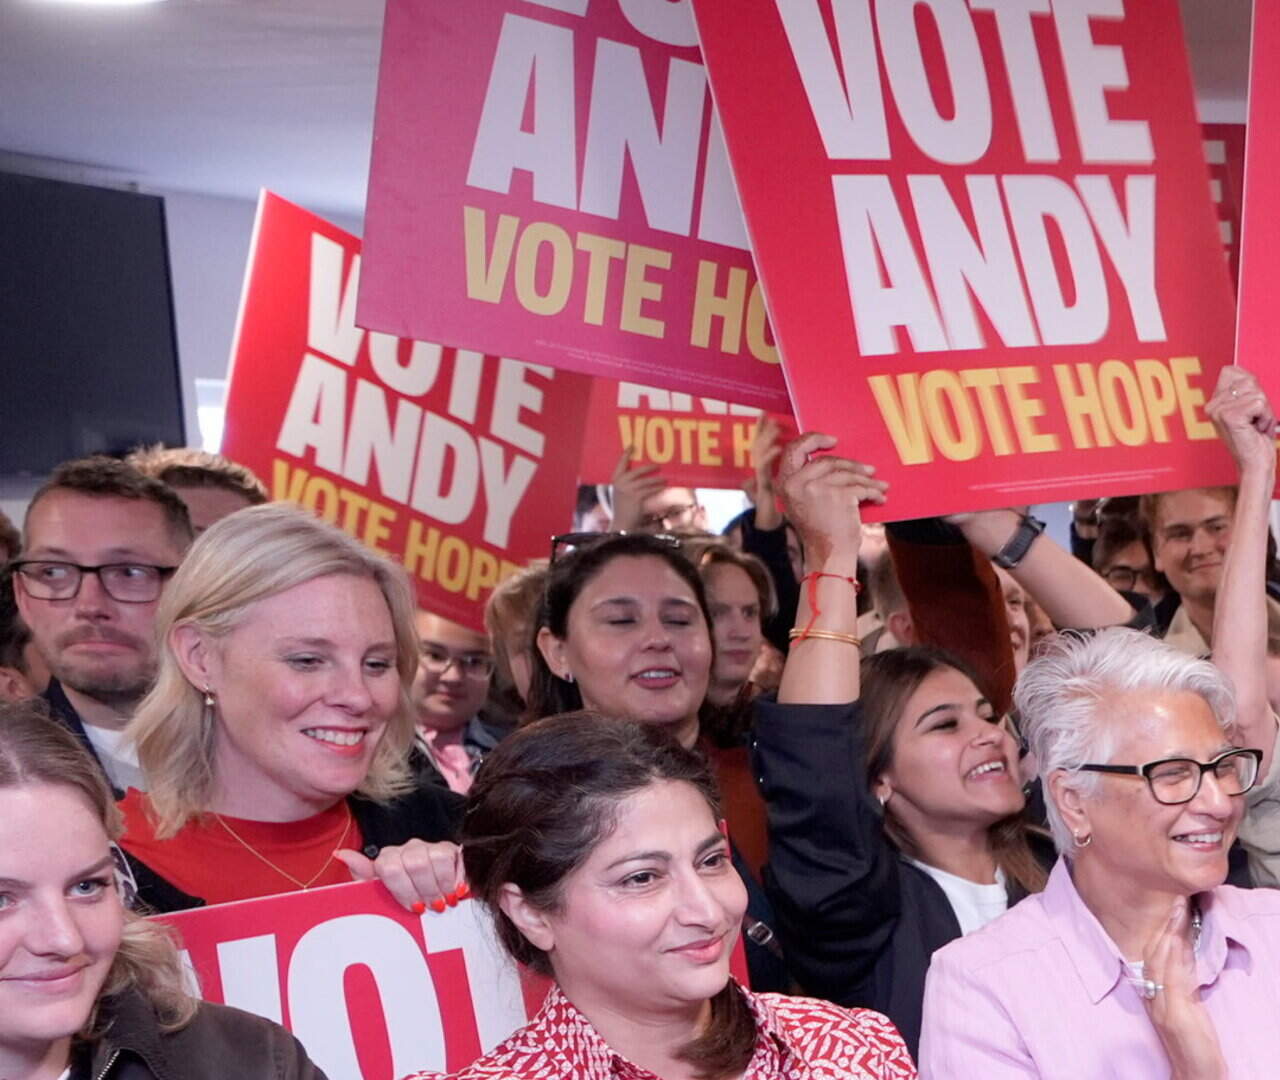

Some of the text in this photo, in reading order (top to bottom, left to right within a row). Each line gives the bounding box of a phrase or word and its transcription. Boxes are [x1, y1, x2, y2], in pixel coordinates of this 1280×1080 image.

[465, 12, 752, 251] AN
[777, 0, 1155, 165] VOTE
[463, 205, 781, 364] VOTE HO
[831, 173, 1167, 356] ANDY
[276, 352, 538, 549] ANDY
[617, 415, 723, 466] VOTE
[867, 365, 1060, 465] VOTE
[1053, 357, 1217, 450] HOPE
